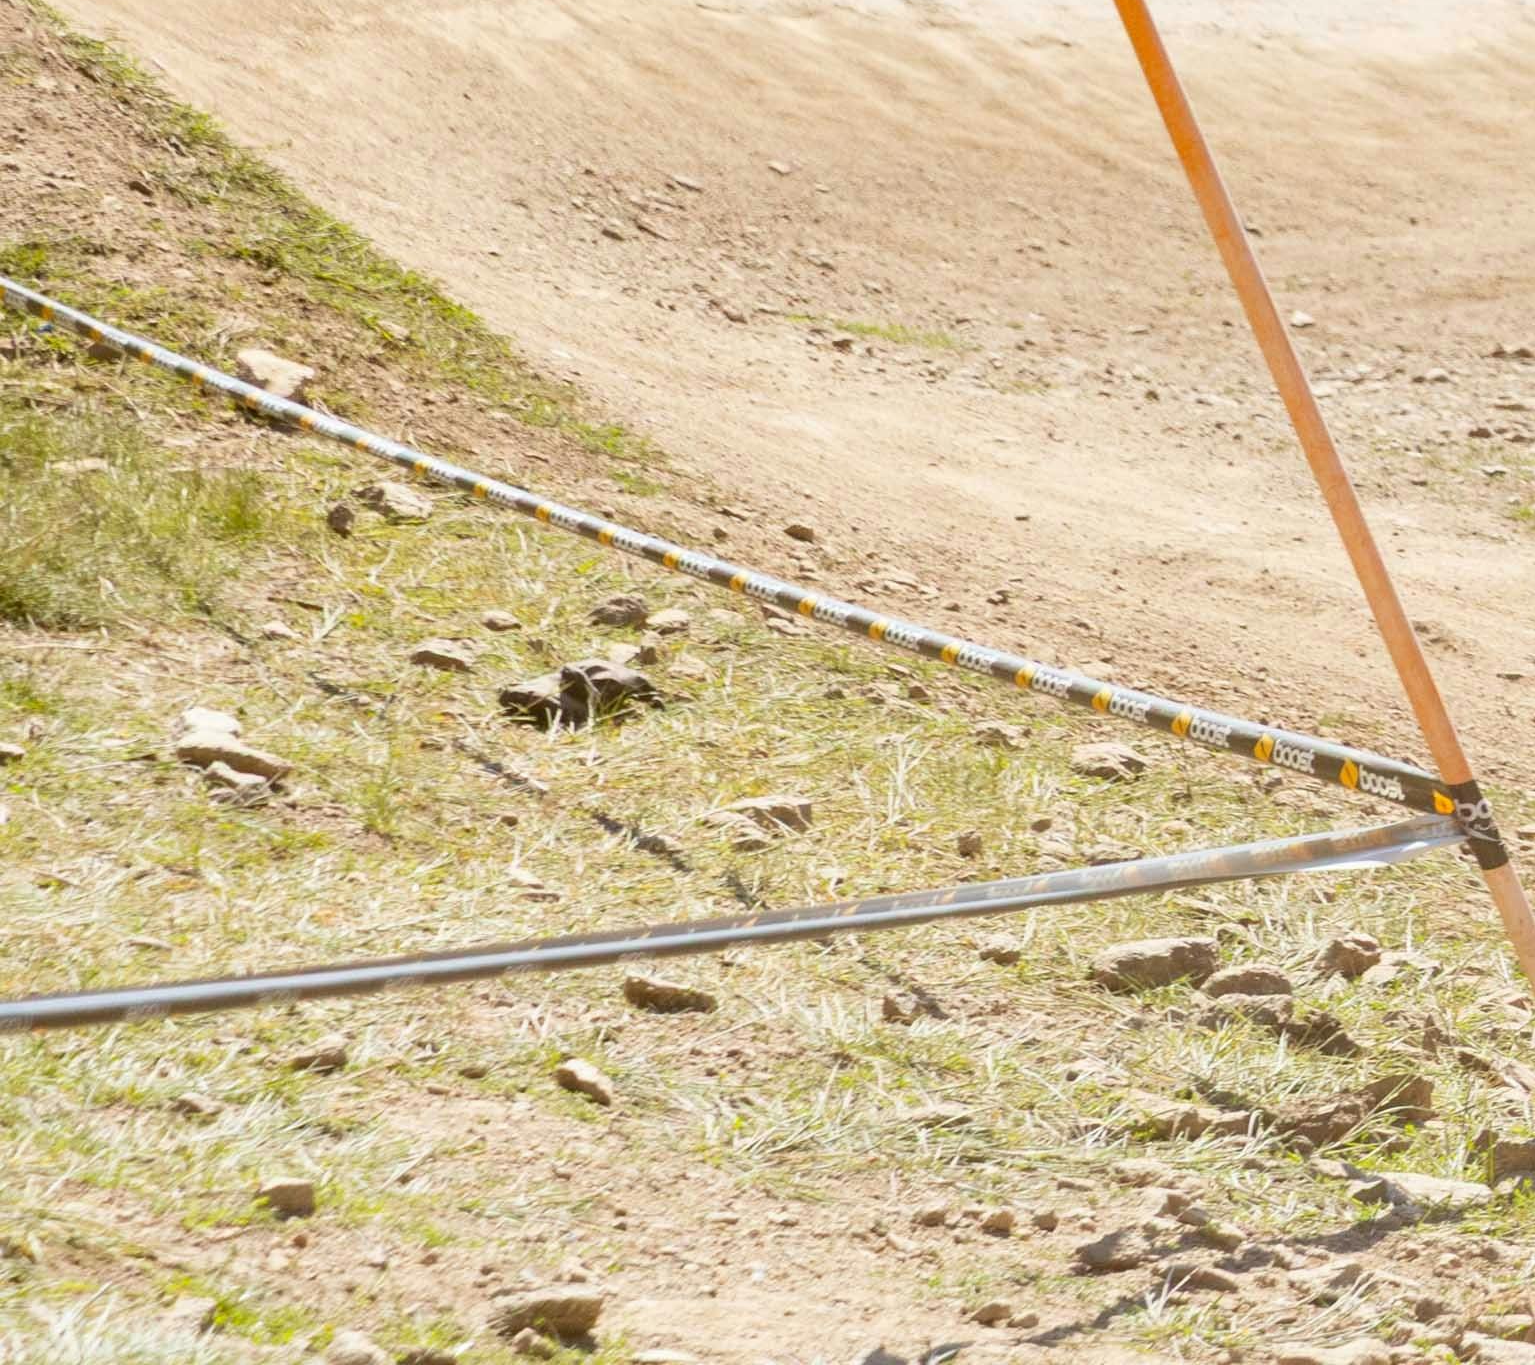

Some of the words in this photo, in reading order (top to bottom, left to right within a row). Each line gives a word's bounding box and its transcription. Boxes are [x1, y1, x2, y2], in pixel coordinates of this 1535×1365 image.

[1110, 692, 1151, 724] boost
[1190, 716, 1232, 748] boost
[1272, 739, 1315, 773] boost
[1358, 765, 1406, 801] boost
